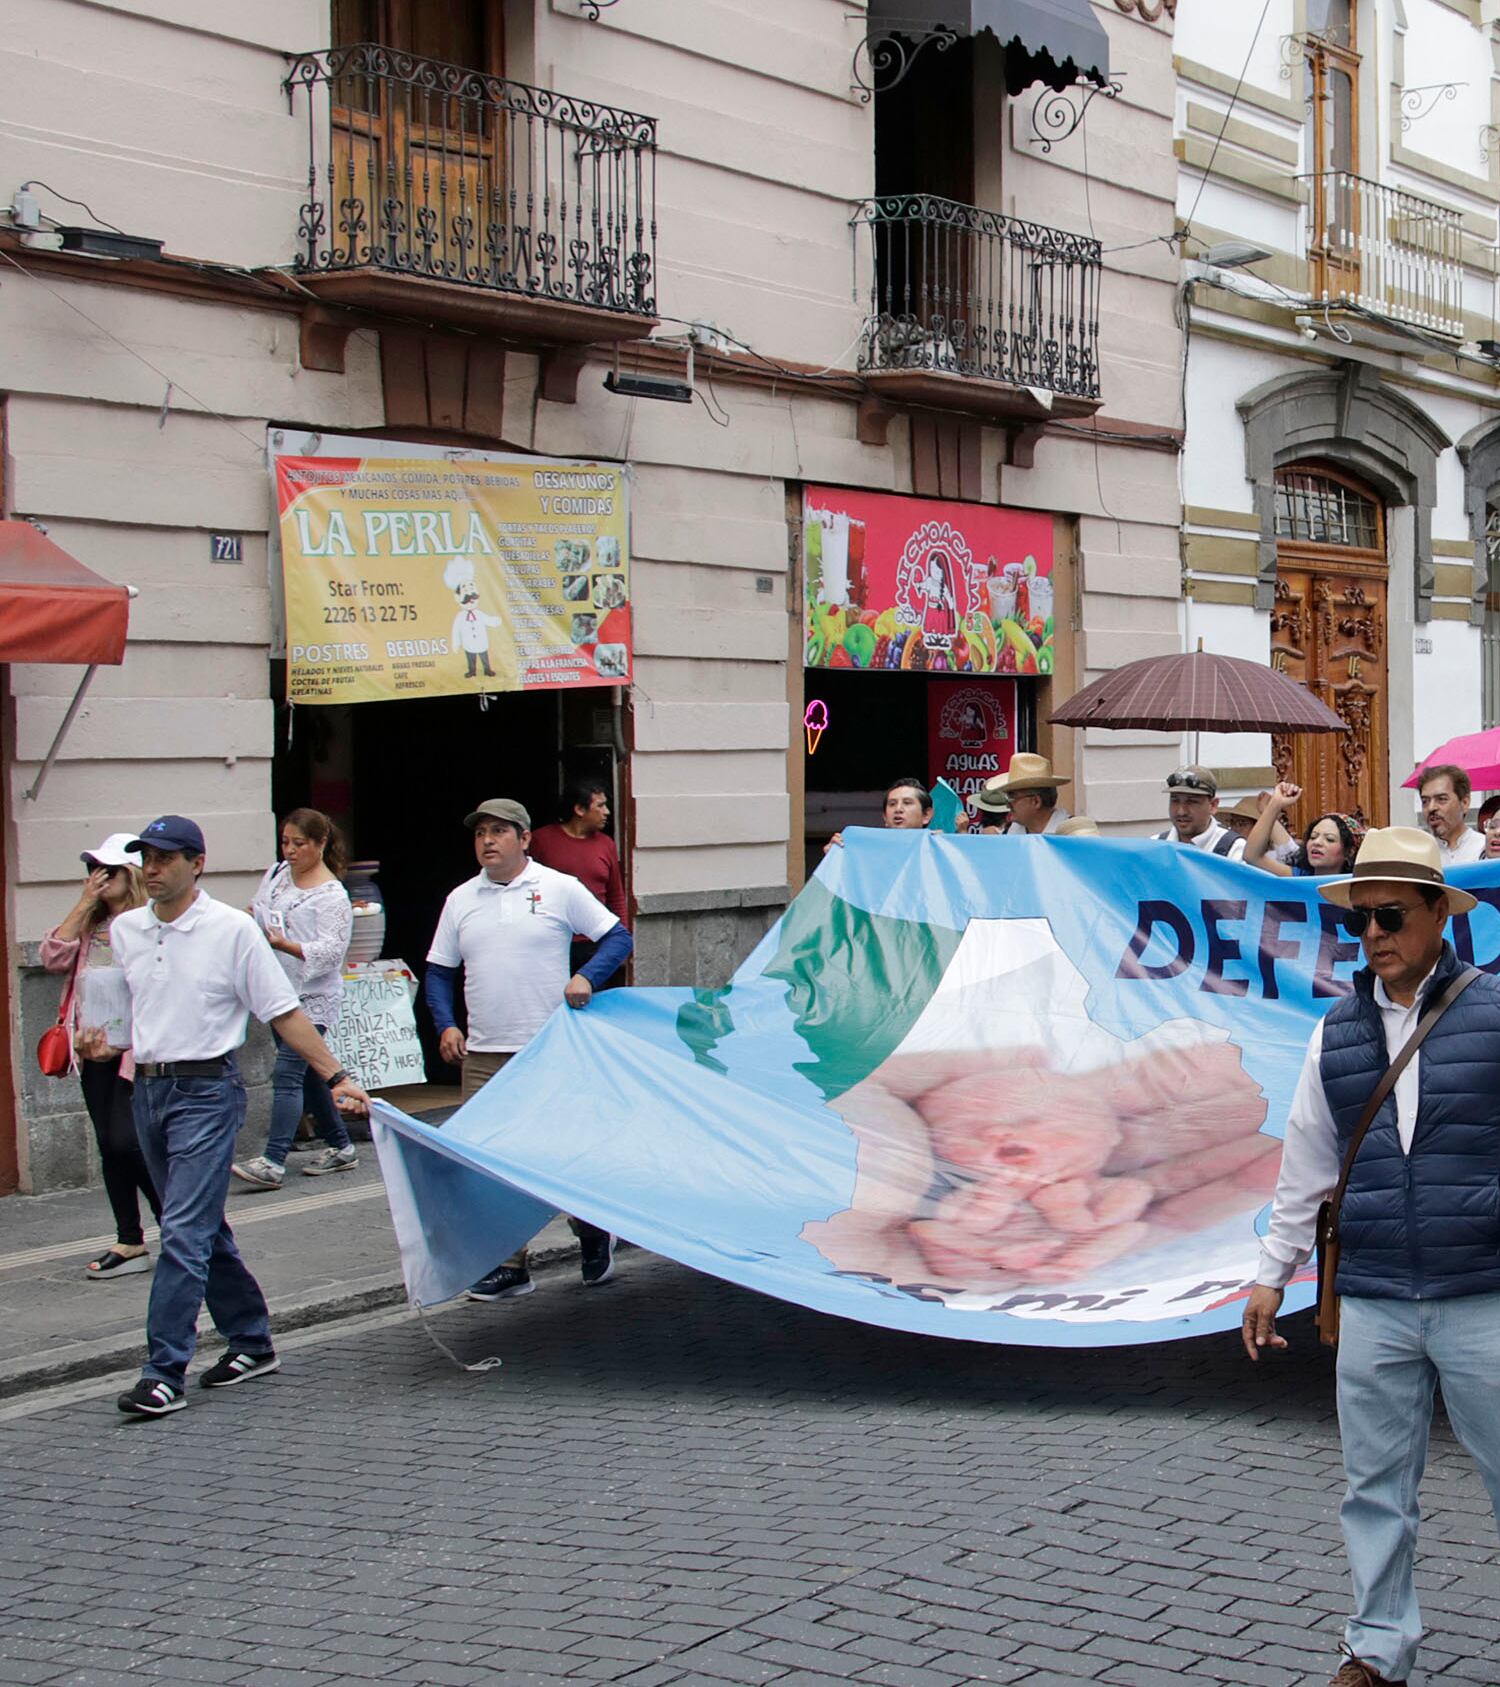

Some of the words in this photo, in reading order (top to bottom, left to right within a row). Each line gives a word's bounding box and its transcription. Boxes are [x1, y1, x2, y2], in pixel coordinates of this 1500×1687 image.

[534, 471, 615, 491] DESAYUNOS
[349, 489, 389, 500] MUCHAS
[391, 490, 420, 500] COSAS
[540, 497, 550, 514] Y
[553, 497, 613, 516] COMIDAS
[293, 508, 357, 557] LA
[361, 509, 496, 557] PERLA
[215, 536, 237, 560] 721
[897, 521, 981, 613] MICHOACANA
[323, 606, 357, 624] 2226
[361, 606, 377, 622] 13
[380, 606, 398, 622] 22
[400, 605, 418, 621] 75
[291, 643, 369, 664] POSTRES
[385, 638, 449, 658] BEBIDAS
[353, 980, 404, 1000] TORTAS
